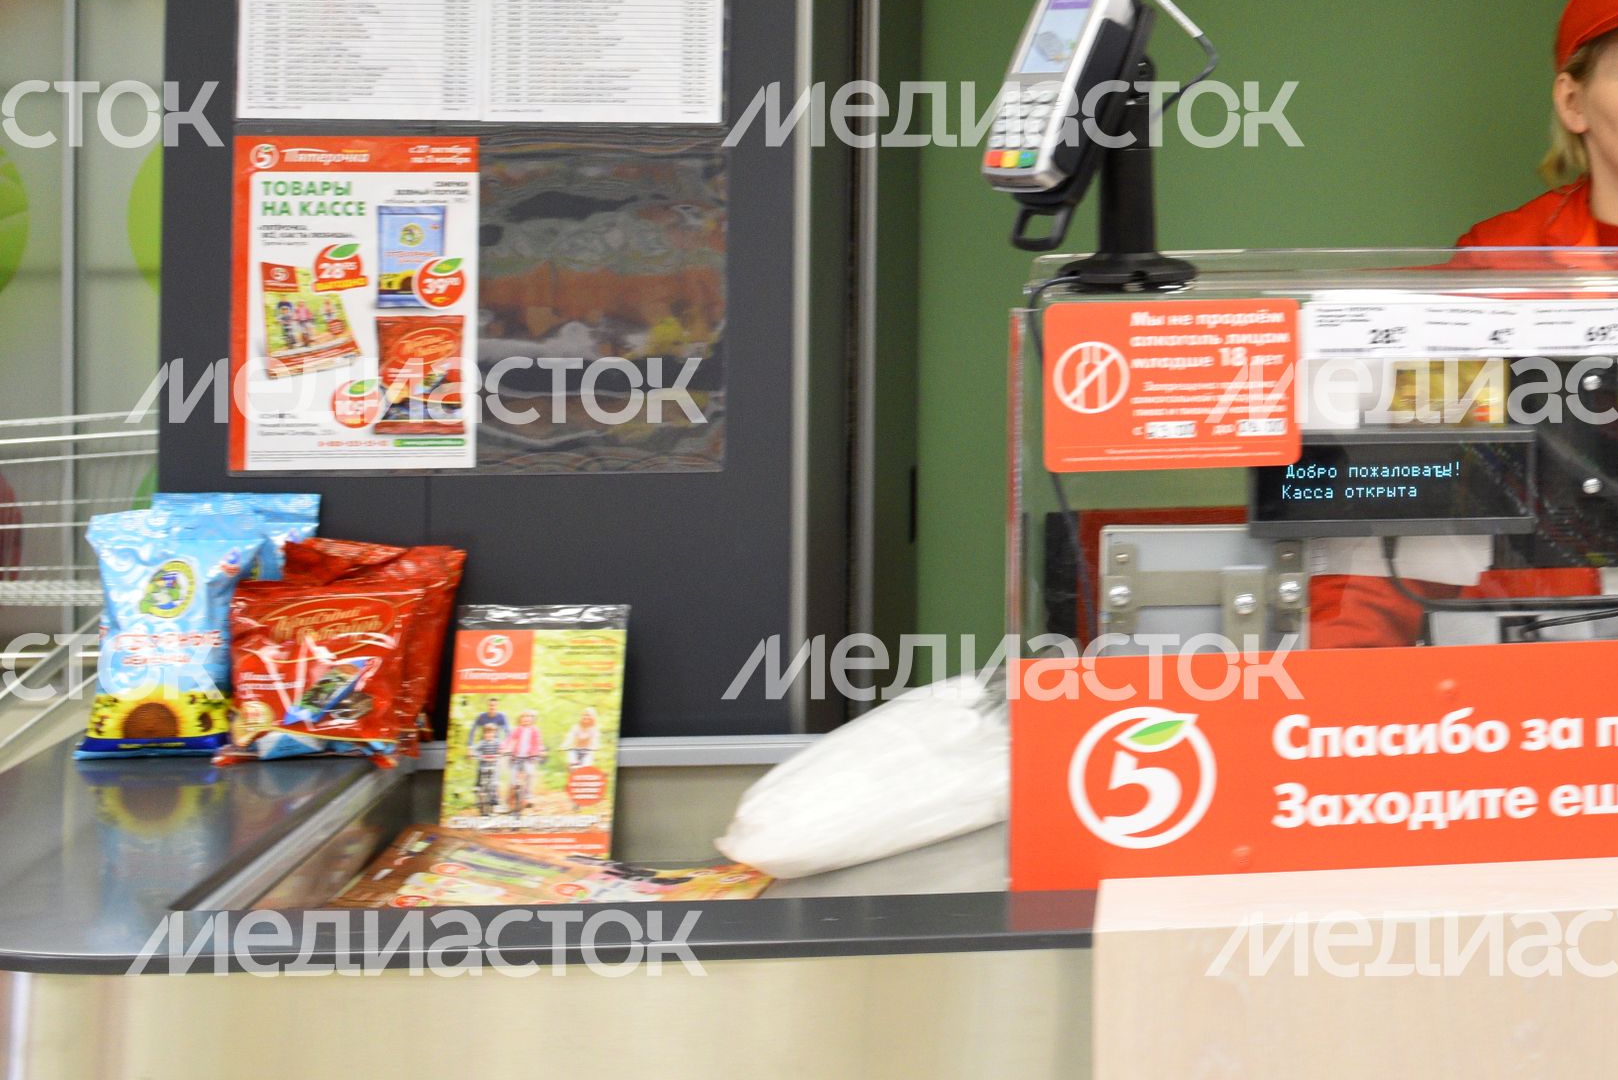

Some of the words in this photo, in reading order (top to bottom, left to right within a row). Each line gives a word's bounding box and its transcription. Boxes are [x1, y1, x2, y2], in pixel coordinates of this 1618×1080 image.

[261, 180, 353, 198] ТОВАРЫ
[261, 200, 297, 217] НА
[300, 200, 367, 217] КАССЕ
[1130, 311, 1164, 327] Мы
[1168, 312, 1193, 326] не
[1130, 333, 1222, 347] алкоголь
[1224, 332, 1289, 347] лицам
[1131, 354, 1214, 370] младше
[1218, 347, 1248, 367] 18
[1250, 353, 1283, 366] лет
[1285, 463, 1338, 479] Добро
[1282, 484, 1335, 500] Касса
[1344, 484, 1418, 498] открыта
[1271, 706, 1510, 762] Спасибо
[1520, 714, 1584, 753] за
[1271, 779, 1537, 833] Заходите
